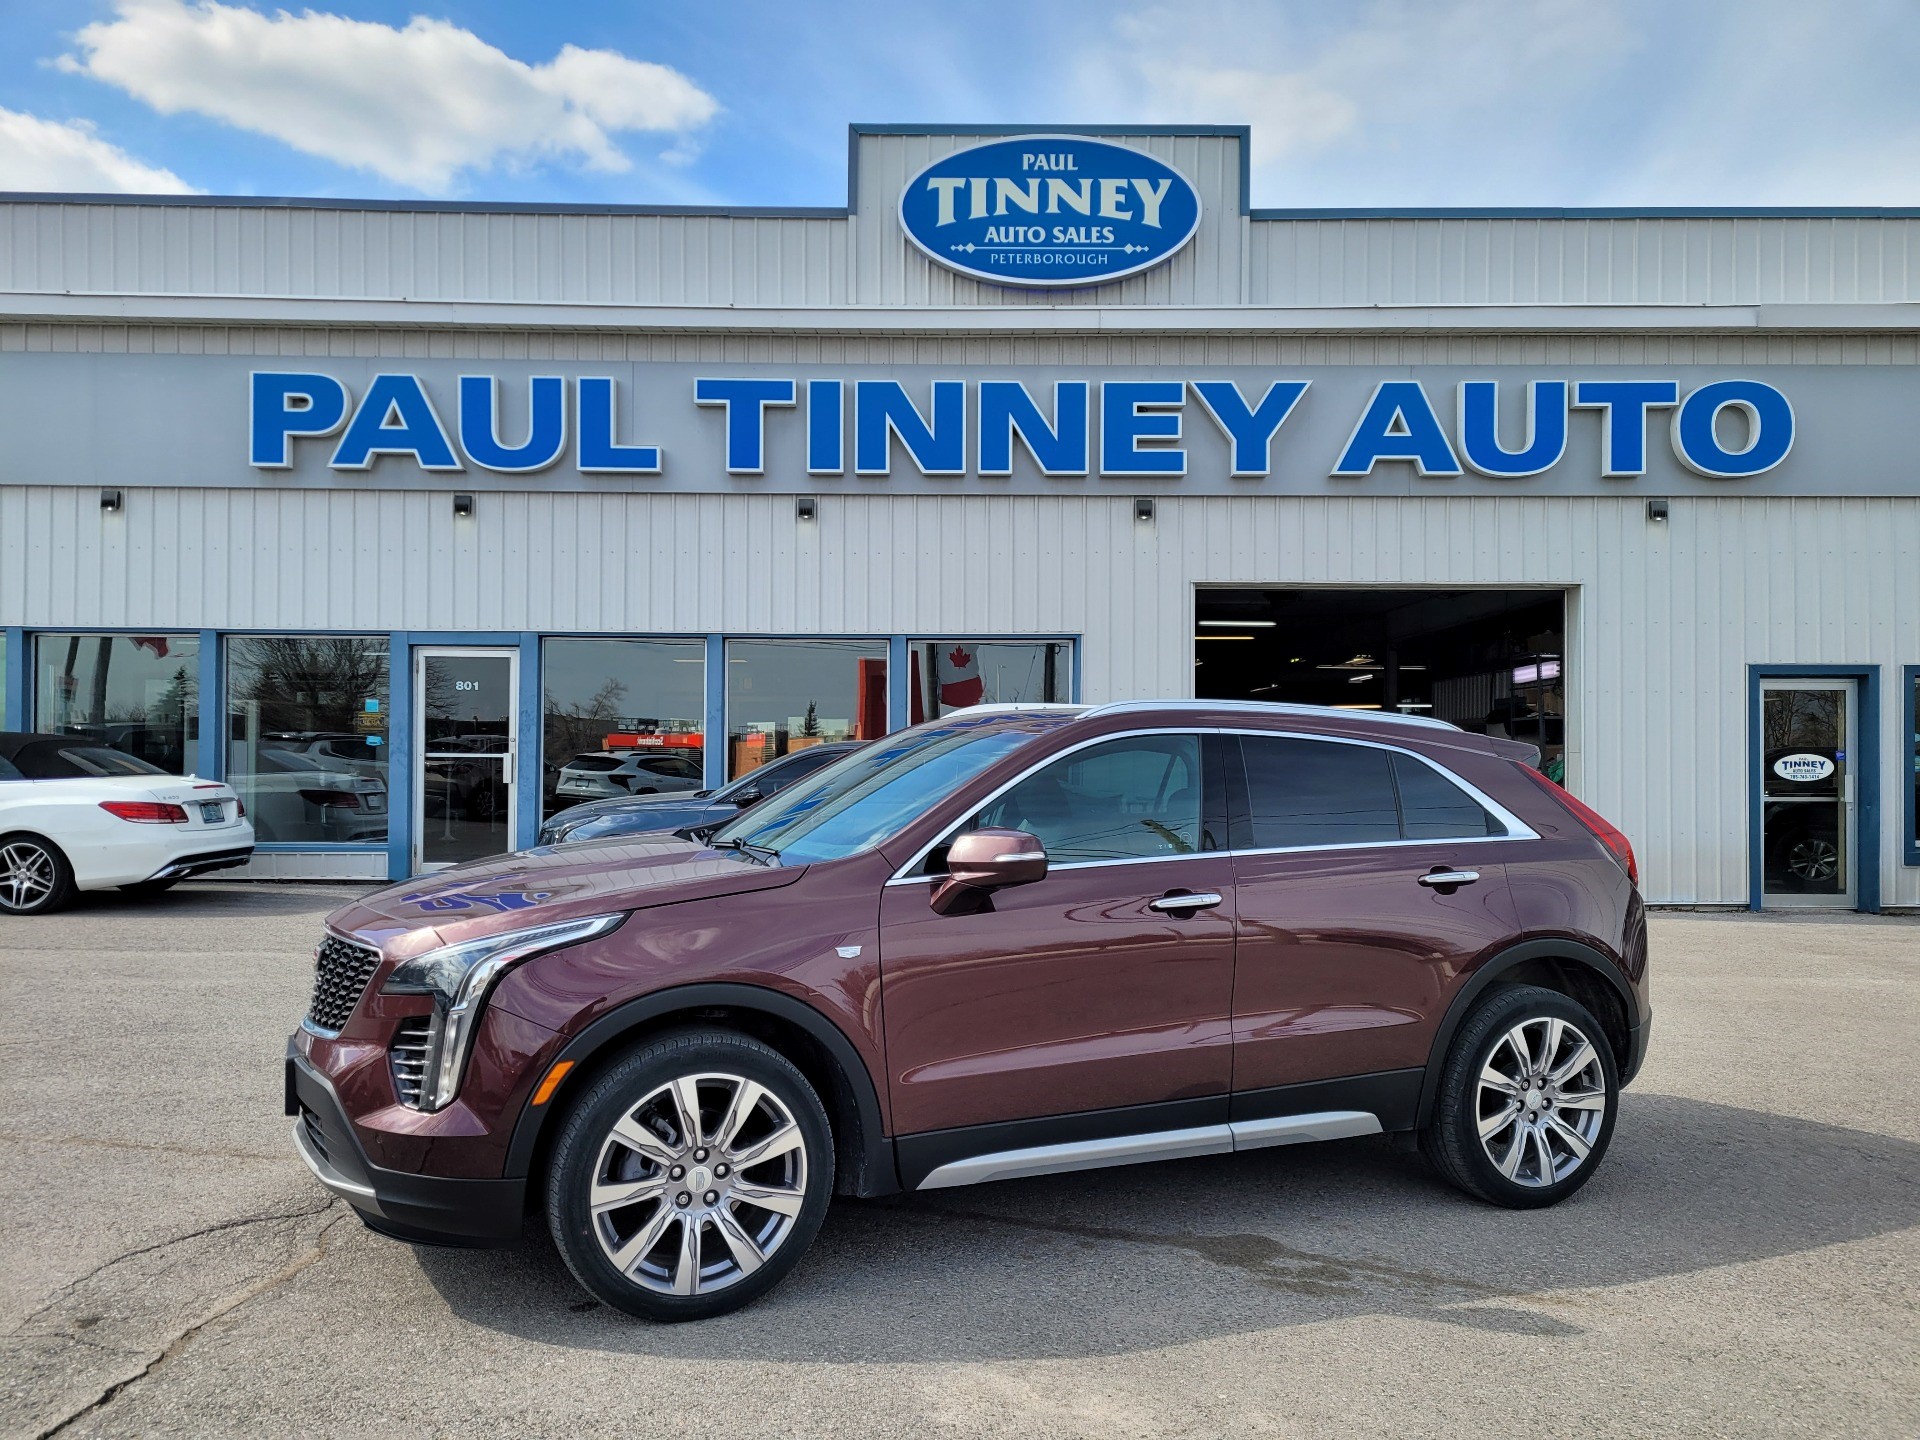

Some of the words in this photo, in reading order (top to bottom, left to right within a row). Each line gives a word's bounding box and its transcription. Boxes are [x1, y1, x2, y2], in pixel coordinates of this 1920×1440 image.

[1022, 153, 1078, 171] PAUL
[926, 177, 1173, 229] TINNEY
[984, 226, 1046, 243] AUTO
[1052, 226, 1115, 244] SALES
[990, 253, 1108, 265] PETERBOROUGH
[249, 370, 662, 475] PAUL
[694, 378, 1313, 478] TINNEY
[1329, 379, 1796, 478] AUTO
[455, 681, 479, 691] 801
[1782, 760, 1826, 771] TINNEY
